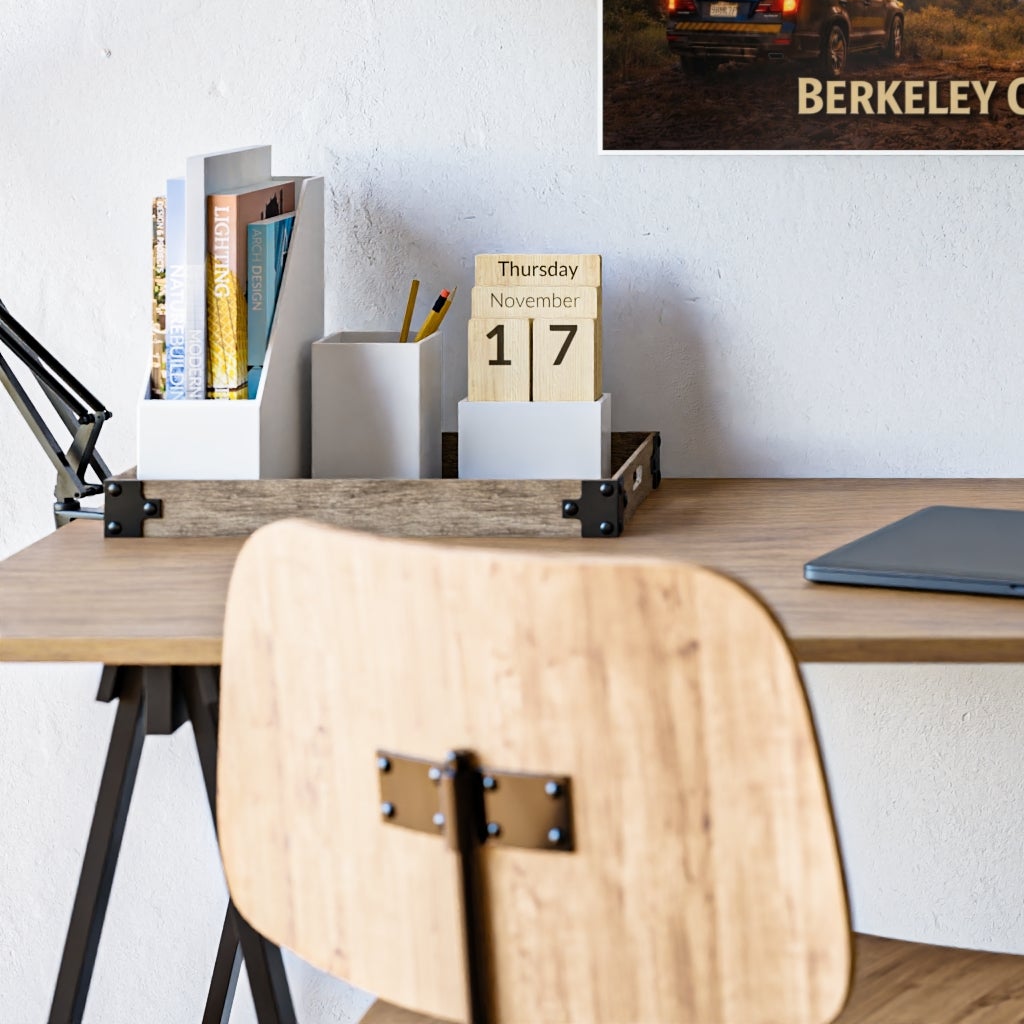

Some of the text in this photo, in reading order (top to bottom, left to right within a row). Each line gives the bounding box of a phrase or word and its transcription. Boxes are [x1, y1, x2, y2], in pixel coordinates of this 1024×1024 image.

[797, 77, 998, 116] BERKELEY
[214, 205, 230, 298] LIGHTING
[251, 229, 263, 311] ARCH DESIGN
[497, 260, 579, 280] Thursday
[490, 292, 580, 308] November
